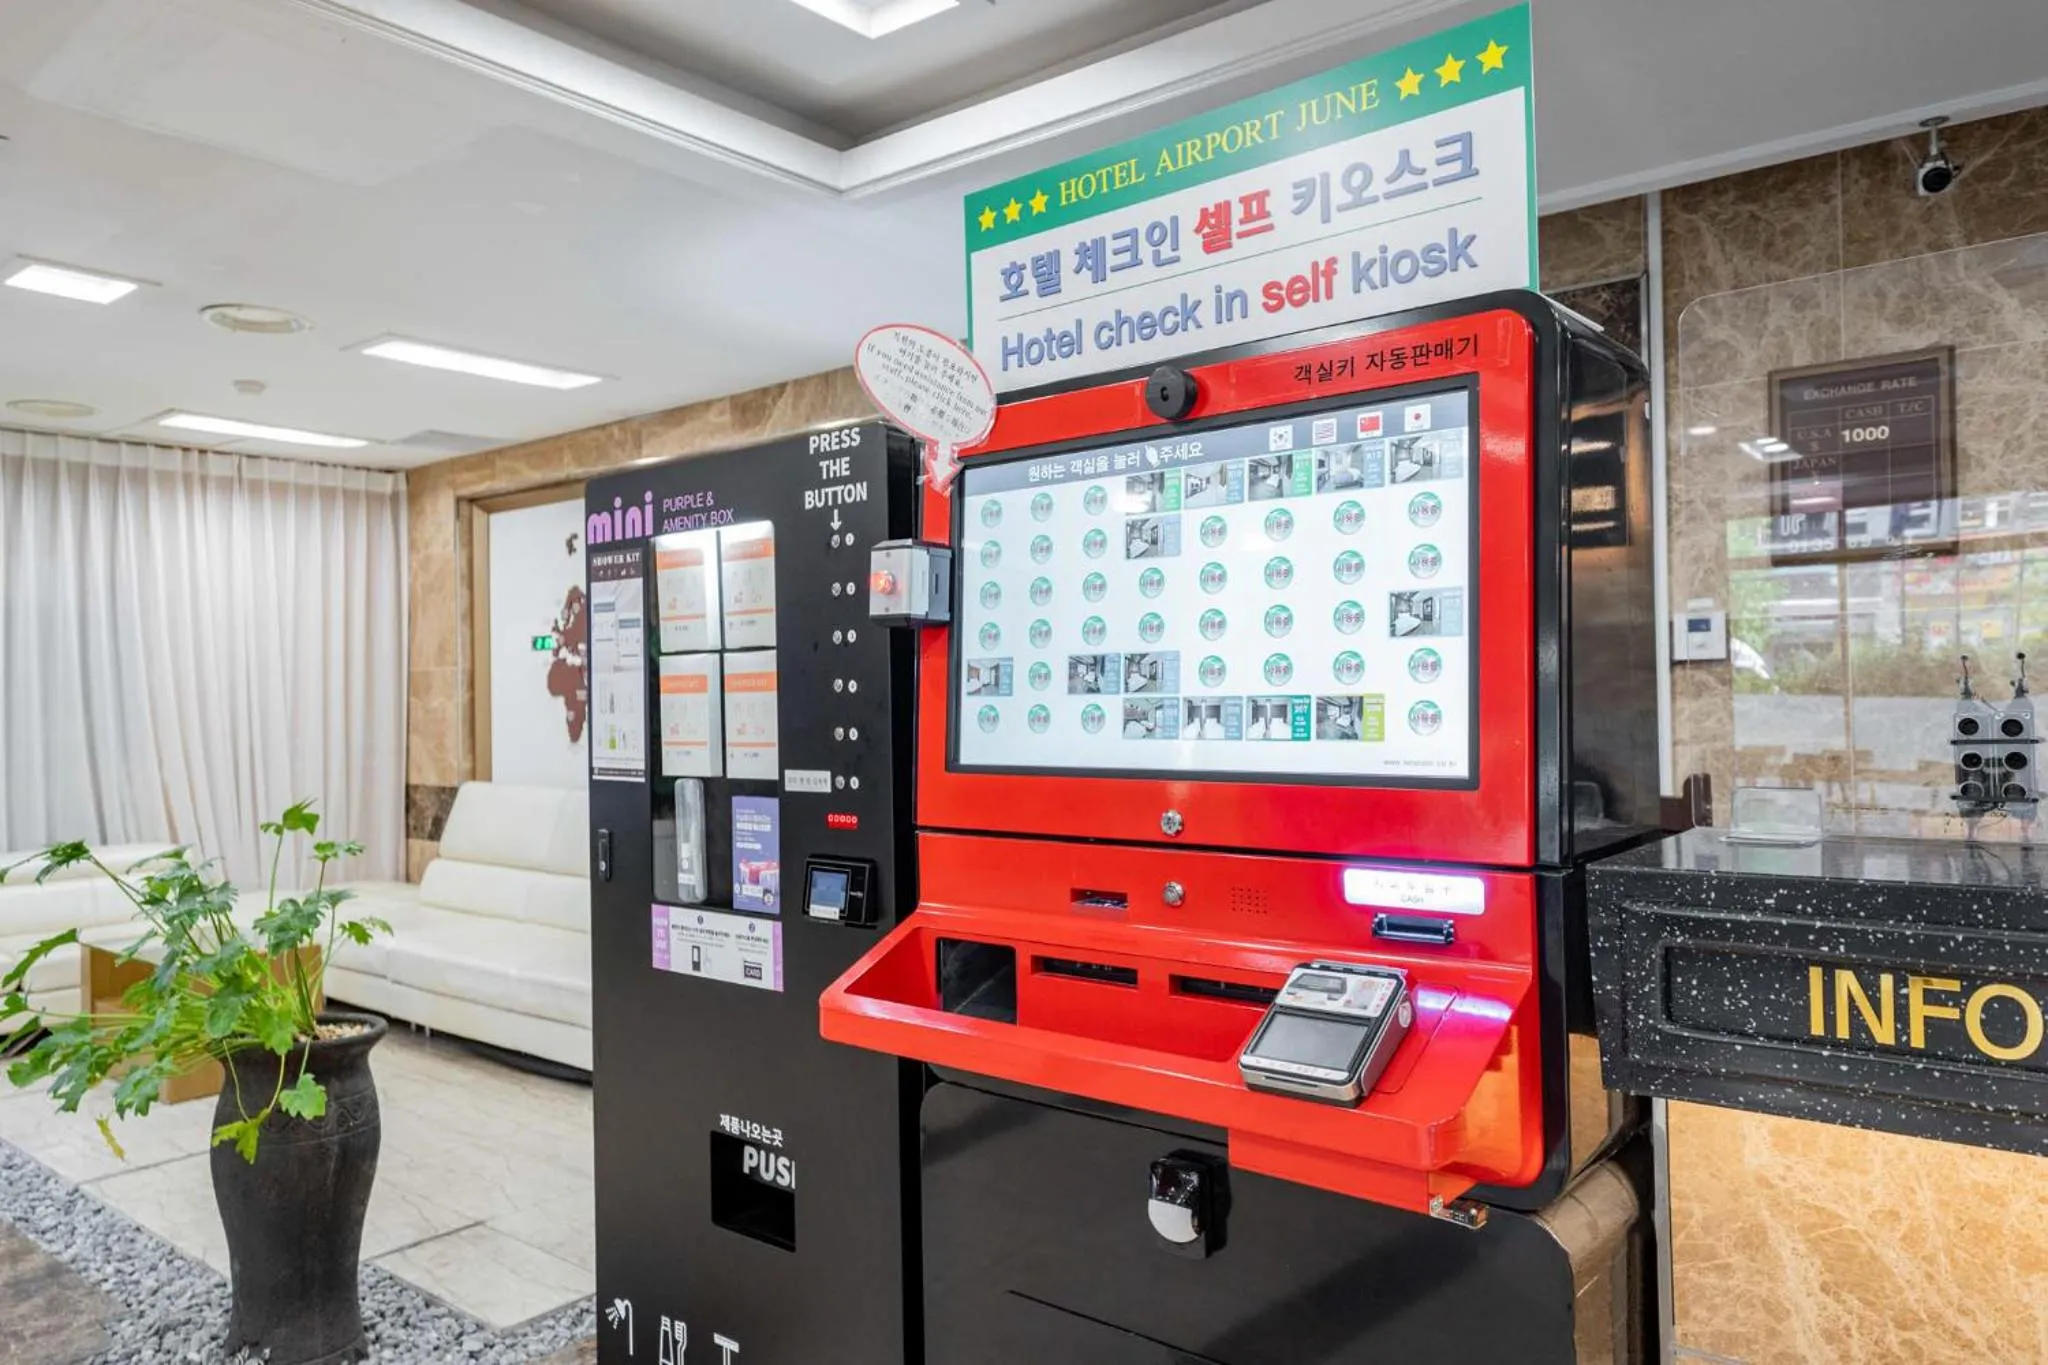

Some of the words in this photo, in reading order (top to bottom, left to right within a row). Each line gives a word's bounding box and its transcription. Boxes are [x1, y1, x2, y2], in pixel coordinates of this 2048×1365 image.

[1058, 158, 1145, 207] HOTEL
[1155, 110, 1285, 177] AIRPORT
[1295, 78, 1380, 132] JUNE
[999, 248, 1062, 303] 호텔
[1073, 214, 1182, 285] 체크인
[1193, 189, 1275, 256] 셀프
[1290, 130, 1480, 226] 키오스크
[1000, 318, 1084, 371] Hotel
[1093, 293, 1203, 352] check
[1214, 284, 1249, 325] in
[1261, 257, 1340, 314] self
[1351, 227, 1479, 294] kiosk
[1294, 351, 1355, 385] 객실키
[1365, 333, 1480, 373] 자동판매기
[1880, 376, 1918, 392] RATE
[1844, 404, 1883, 420] CASH
[809, 427, 861, 455] PRESS
[1841, 425, 1890, 443] 1000
[819, 456, 850, 480] THE
[1028, 463, 1066, 483] 원하는
[1070, 455, 1110, 477] 객실을
[1113, 451, 1141, 471] 눌러
[1159, 442, 1203, 465] 주세요
[1793, 456, 1837, 470] JAPAN
[663, 493, 704, 513] PURPLE
[706, 491, 715, 507] &
[804, 481, 868, 510] BUTTON
[587, 490, 653, 545] mini
[662, 512, 708, 533] AMENITY
[710, 508, 735, 527] BOX
[593, 554, 625, 567] SHOWER
[626, 551, 640, 564] KIT
[1809, 965, 2045, 1061] INFO
[720, 1113, 784, 1148] 제품나오는곳
